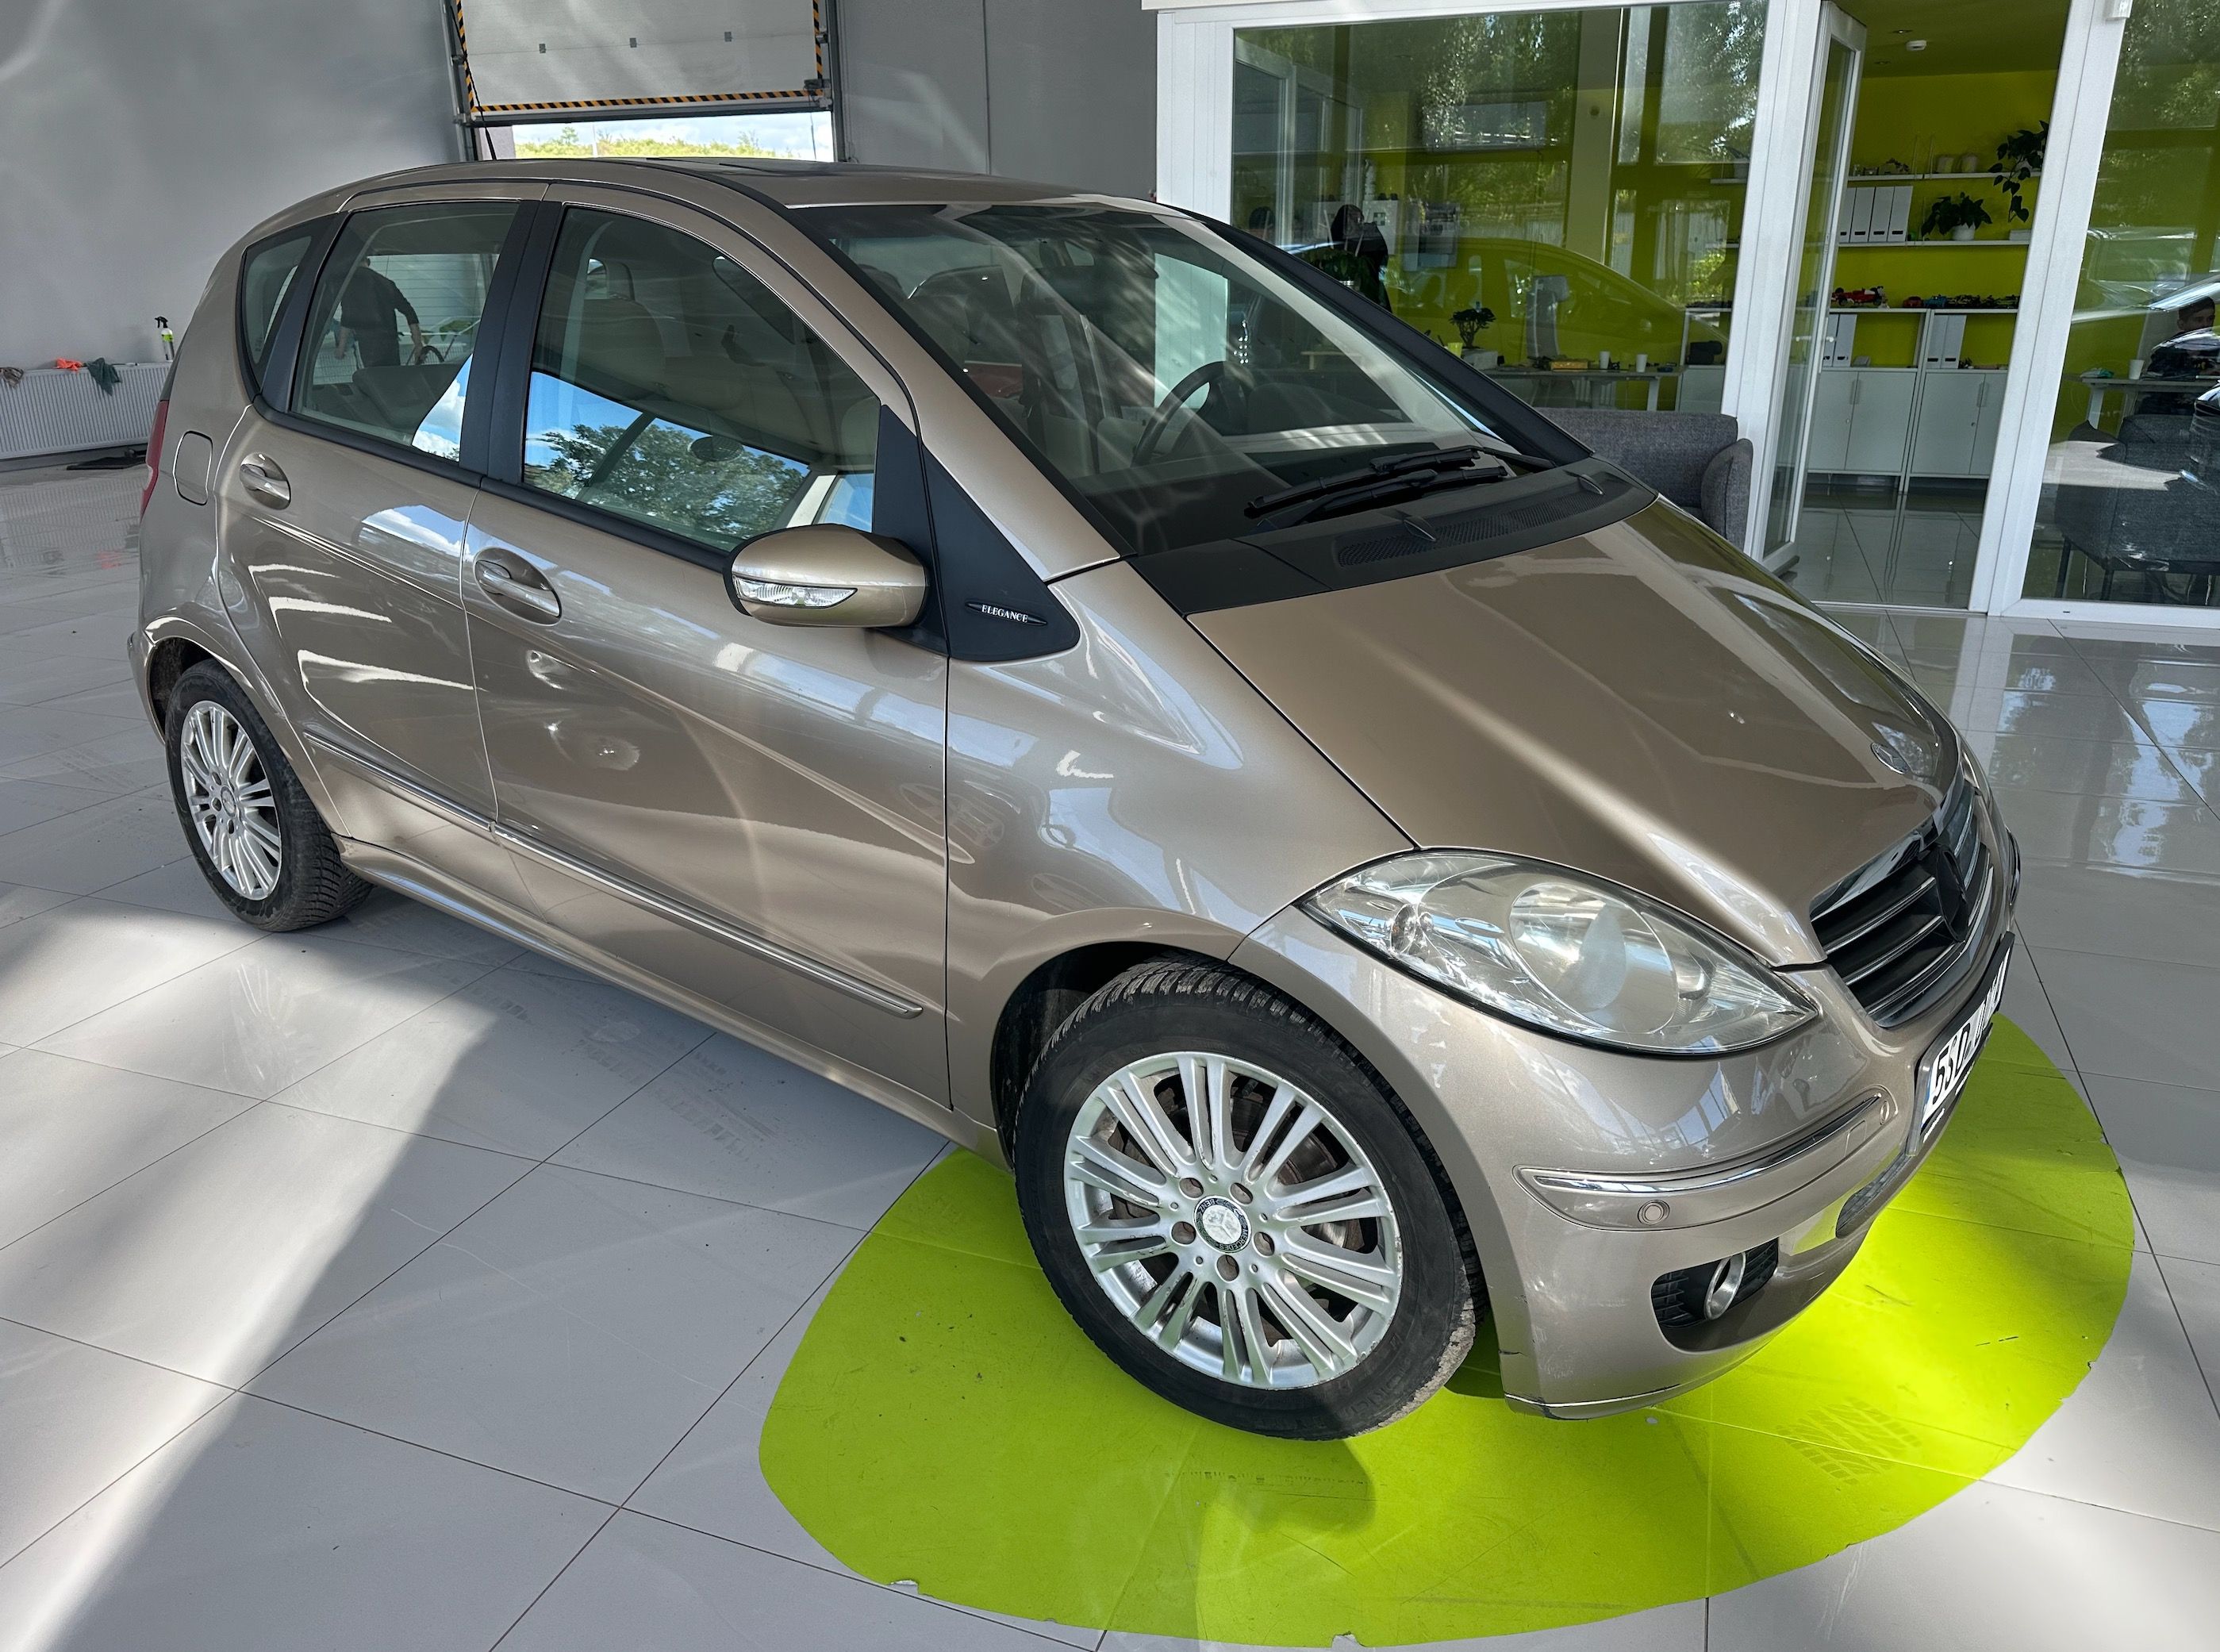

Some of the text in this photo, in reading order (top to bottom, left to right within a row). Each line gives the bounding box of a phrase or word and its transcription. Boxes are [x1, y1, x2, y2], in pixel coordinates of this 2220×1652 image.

[981, 604, 1029, 623] ELEGANCE
[1198, 1198, 1216, 1213] BENZ
[1219, 1228, 1249, 1251] MERCEDES
